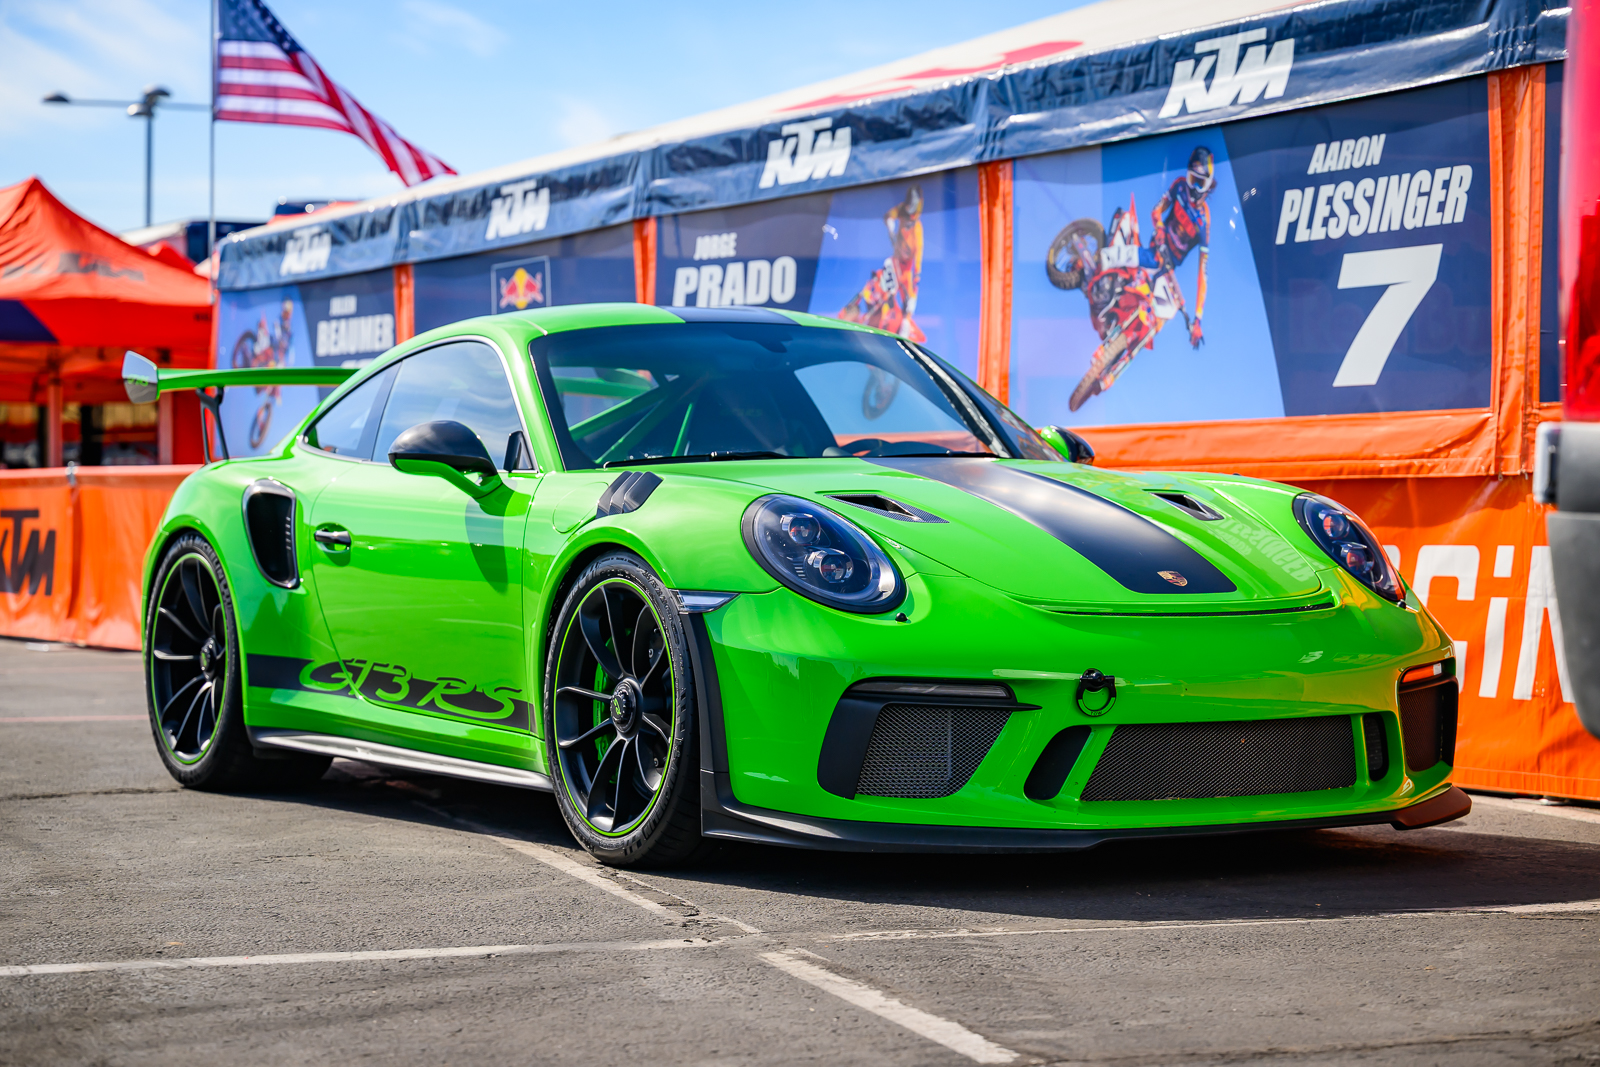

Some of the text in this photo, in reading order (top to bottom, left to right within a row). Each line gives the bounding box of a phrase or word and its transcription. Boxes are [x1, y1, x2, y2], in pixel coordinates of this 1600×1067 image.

[1157, 28, 1295, 119] KTM
[759, 117, 852, 189] KTM
[1307, 134, 1386, 175] AARON
[485, 179, 550, 241] KTM
[1275, 164, 1473, 246] PLESSINGER
[279, 227, 332, 277] KTM
[693, 232, 738, 261] JORGE
[672, 255, 798, 308] PRADO
[1332, 243, 1444, 388] 7
[299, 658, 523, 720] GT3 RS
